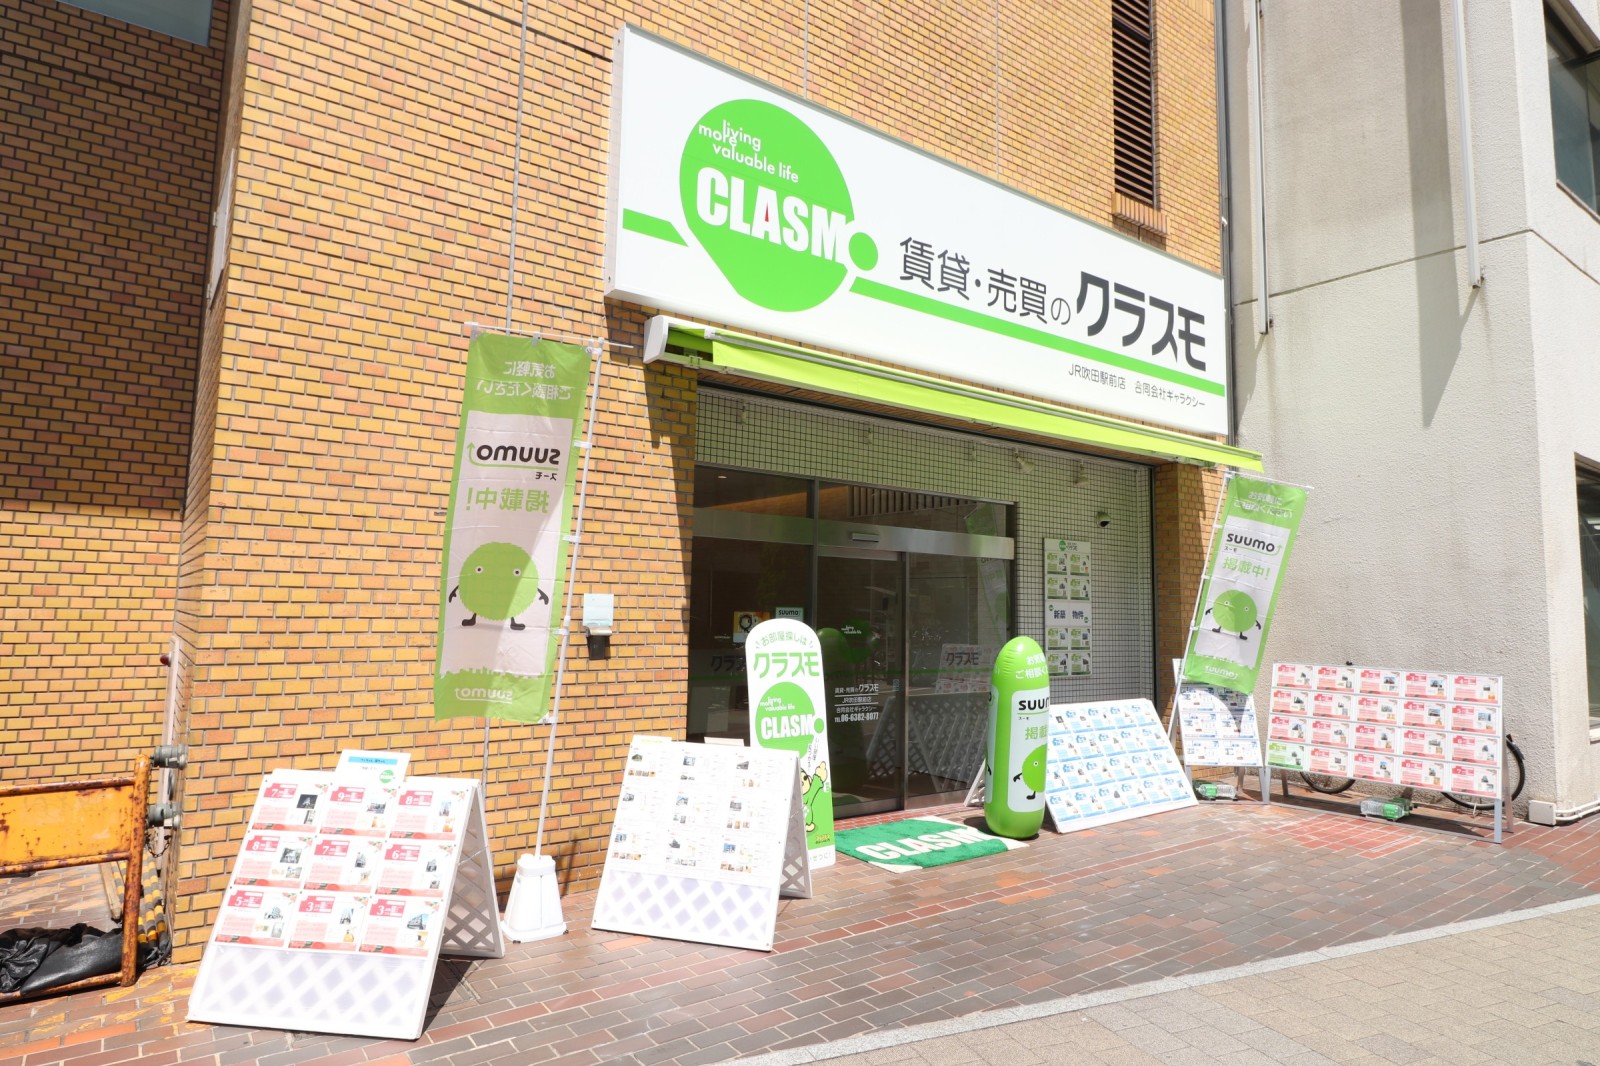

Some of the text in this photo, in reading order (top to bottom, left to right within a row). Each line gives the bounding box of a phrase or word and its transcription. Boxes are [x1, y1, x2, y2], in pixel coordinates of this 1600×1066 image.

[698, 124, 738, 147] more
[722, 120, 761, 151] living
[713, 144, 799, 183] valuable life
[1068, 364, 1206, 407] JR吹田駅前店 合同会社ギャラクシー
[753, 652, 820, 679] クラスモ
[945, 652, 979, 666] クラスモ
